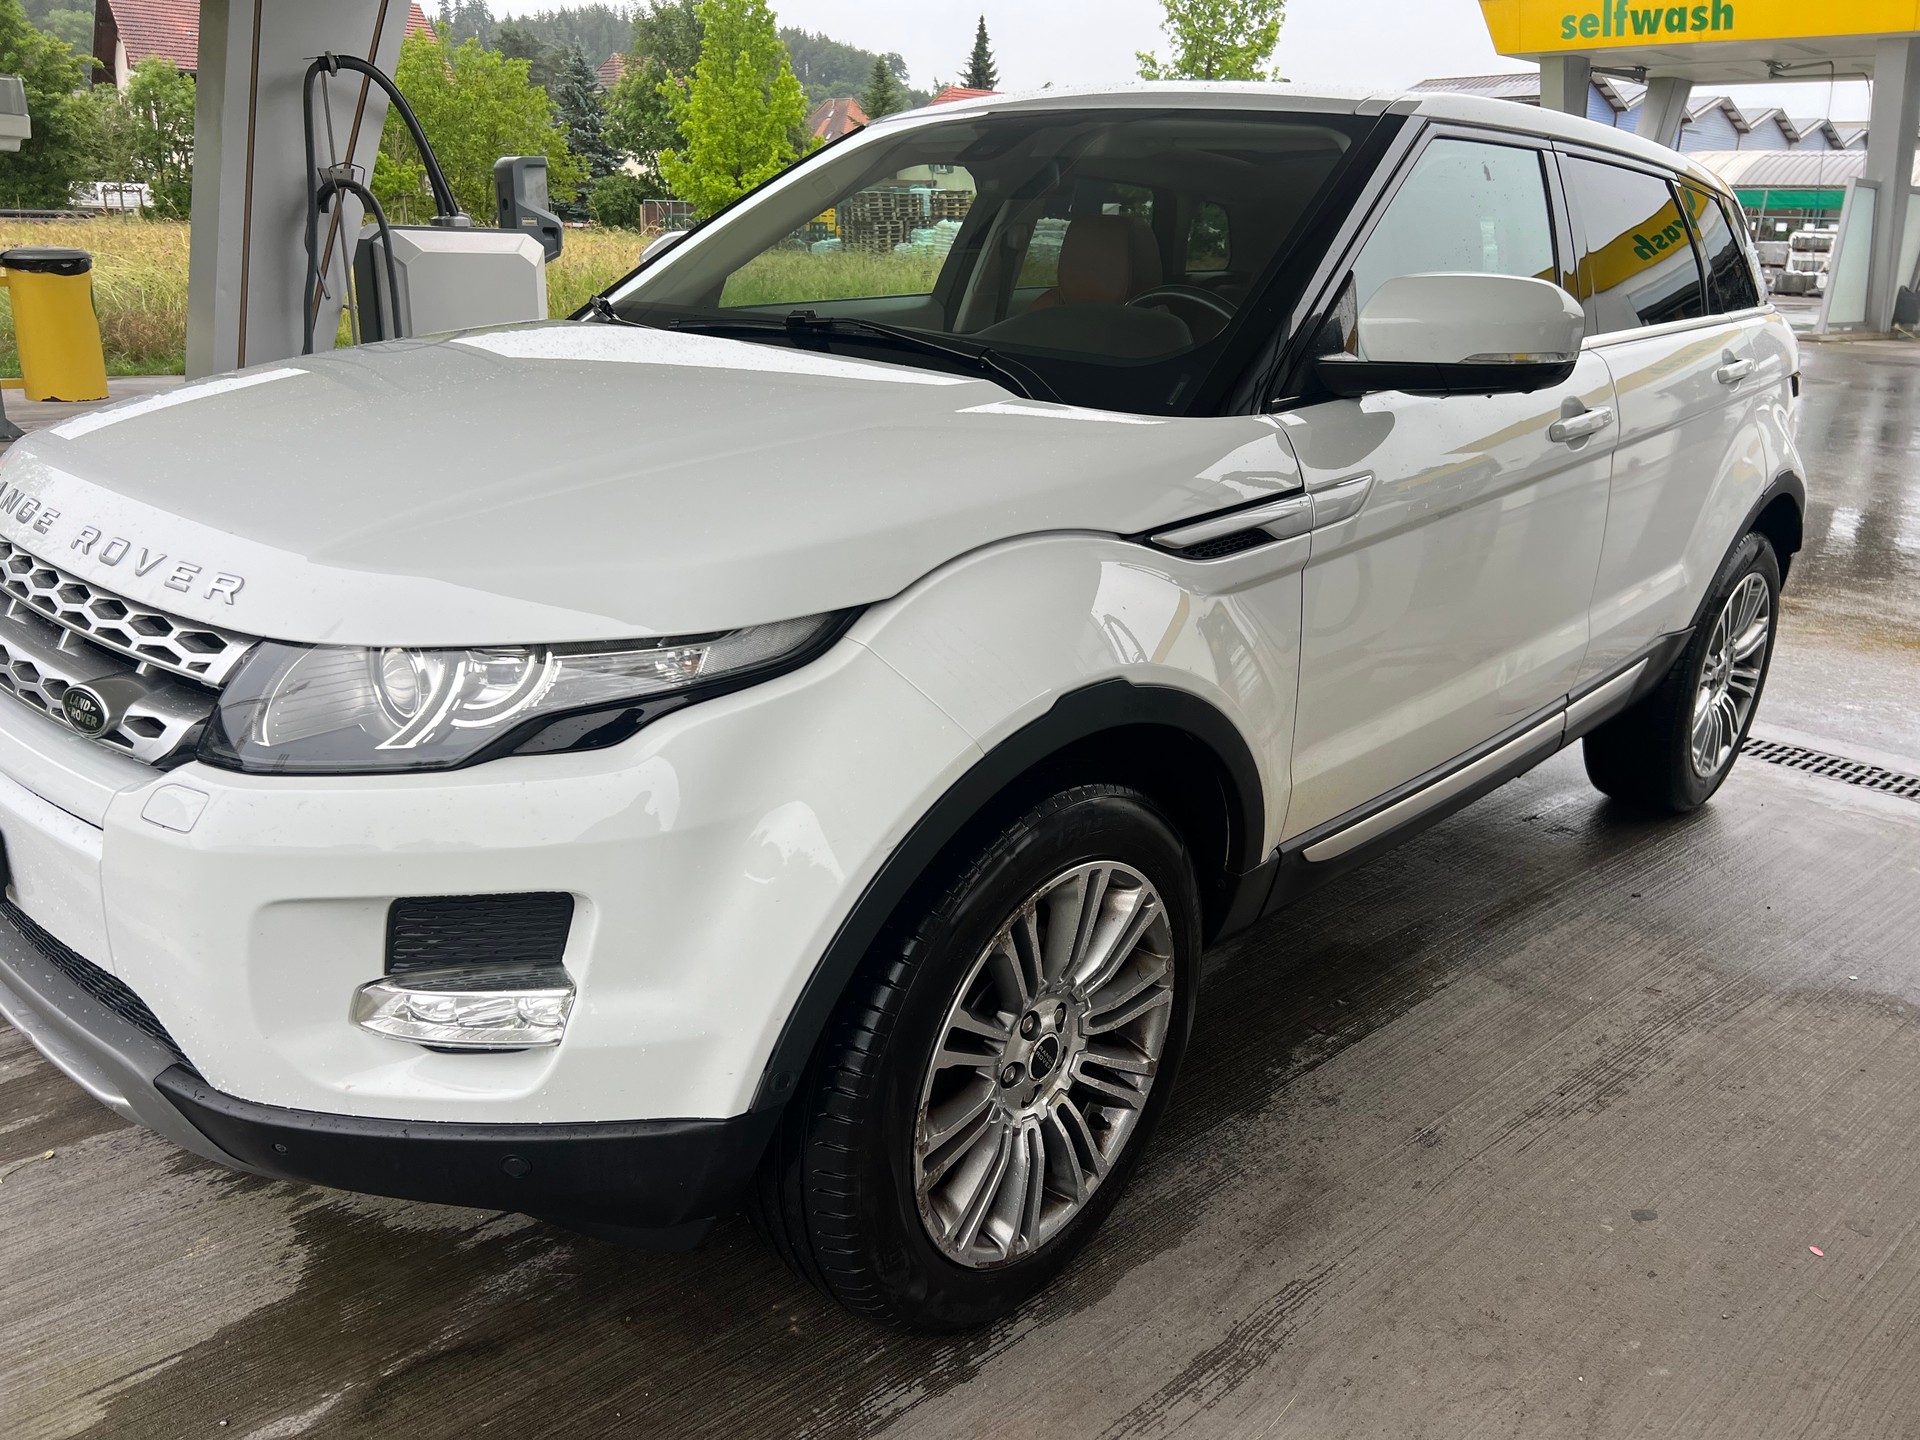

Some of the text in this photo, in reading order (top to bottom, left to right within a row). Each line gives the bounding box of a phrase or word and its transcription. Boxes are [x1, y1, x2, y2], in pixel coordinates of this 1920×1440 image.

[1561, 0, 1734, 39] selfwash
[70, 525, 245, 605] ROVER
[70, 693, 91, 711] LAND
[70, 707, 98, 728] ROVER
[1035, 1050, 1052, 1069] ROVER
[1038, 1045, 1054, 1064] RANGE
